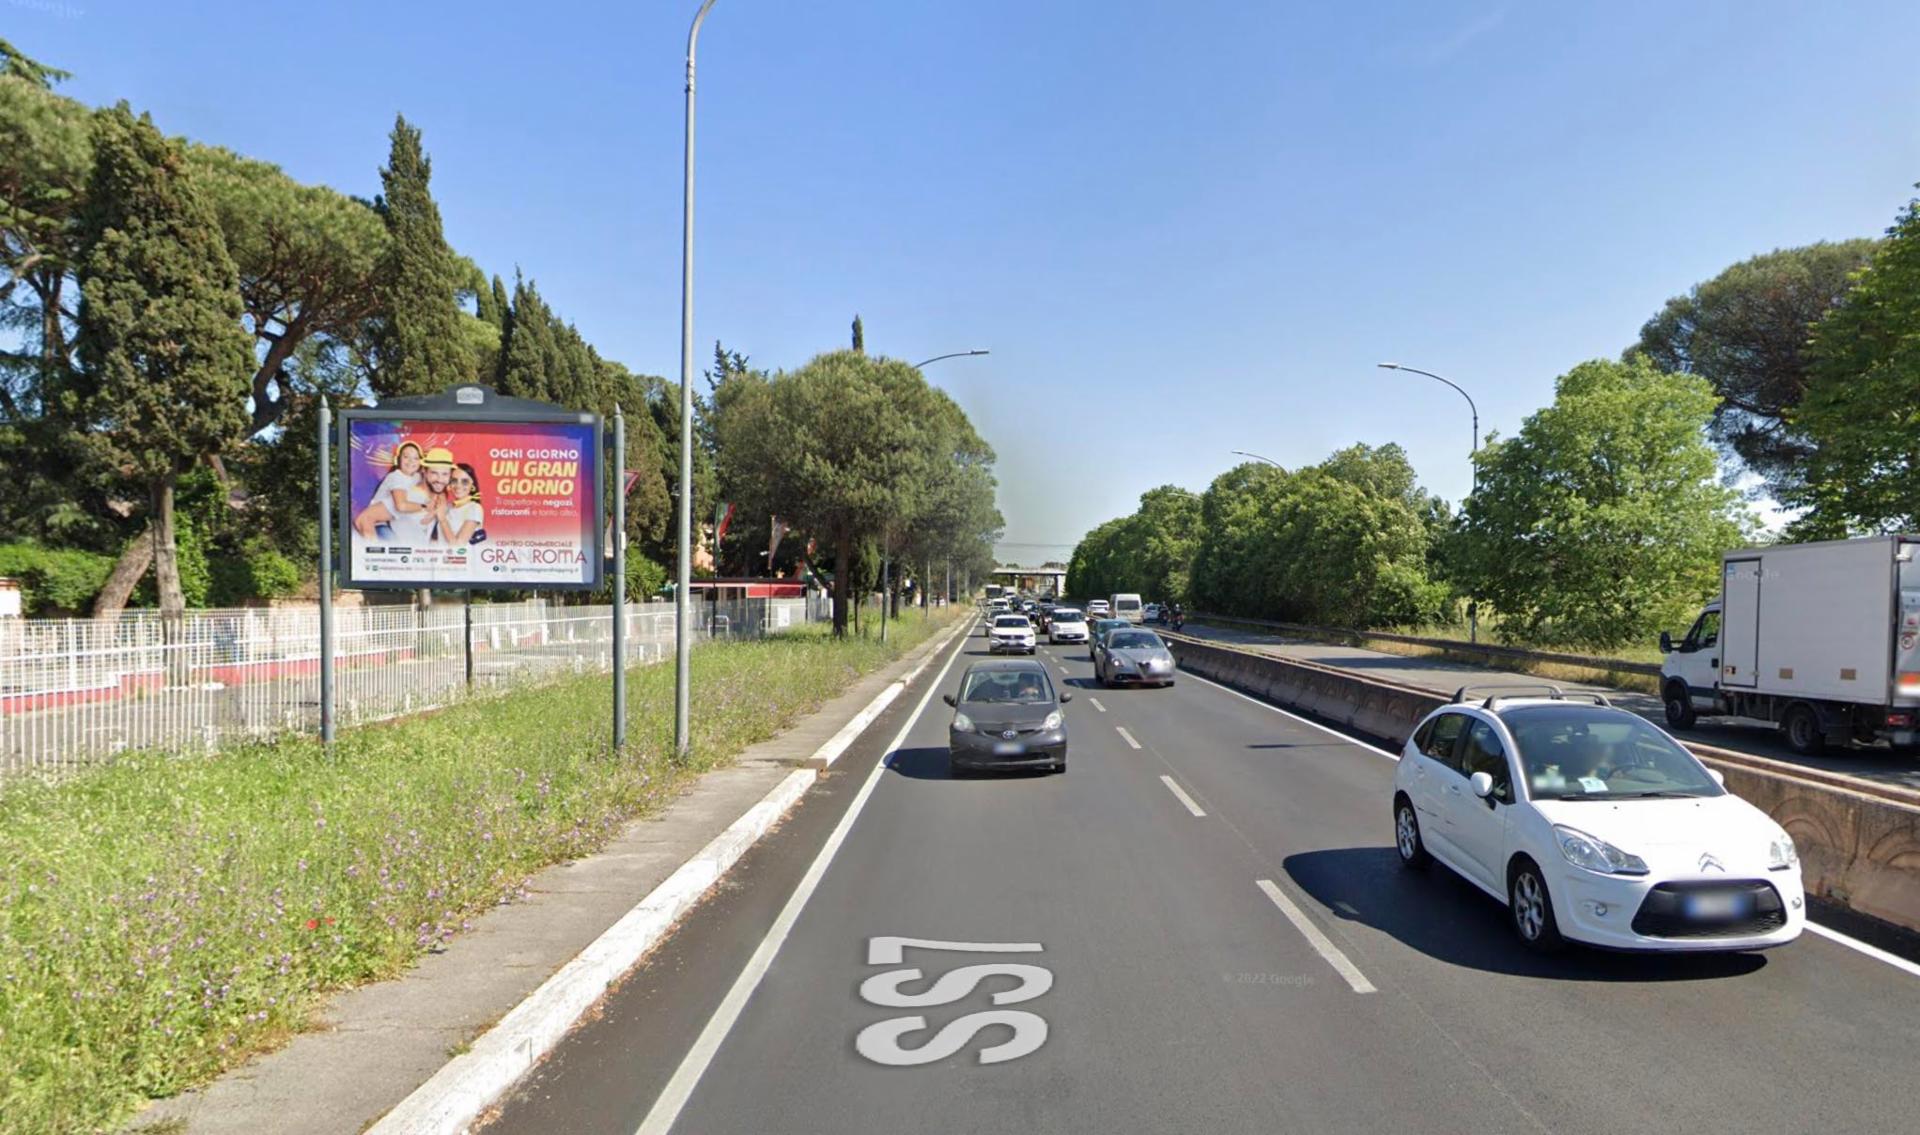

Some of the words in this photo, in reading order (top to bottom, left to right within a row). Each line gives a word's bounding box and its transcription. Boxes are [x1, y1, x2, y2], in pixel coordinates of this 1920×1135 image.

[489, 448, 523, 459] OGNI
[526, 449, 579, 460] GIORNO
[491, 460, 520, 477] UN
[523, 460, 578, 478] GRAN
[496, 478, 574, 496] GIORNO
[491, 507, 530, 516] ristoranti
[524, 540, 573, 548] COMMERCIALE
